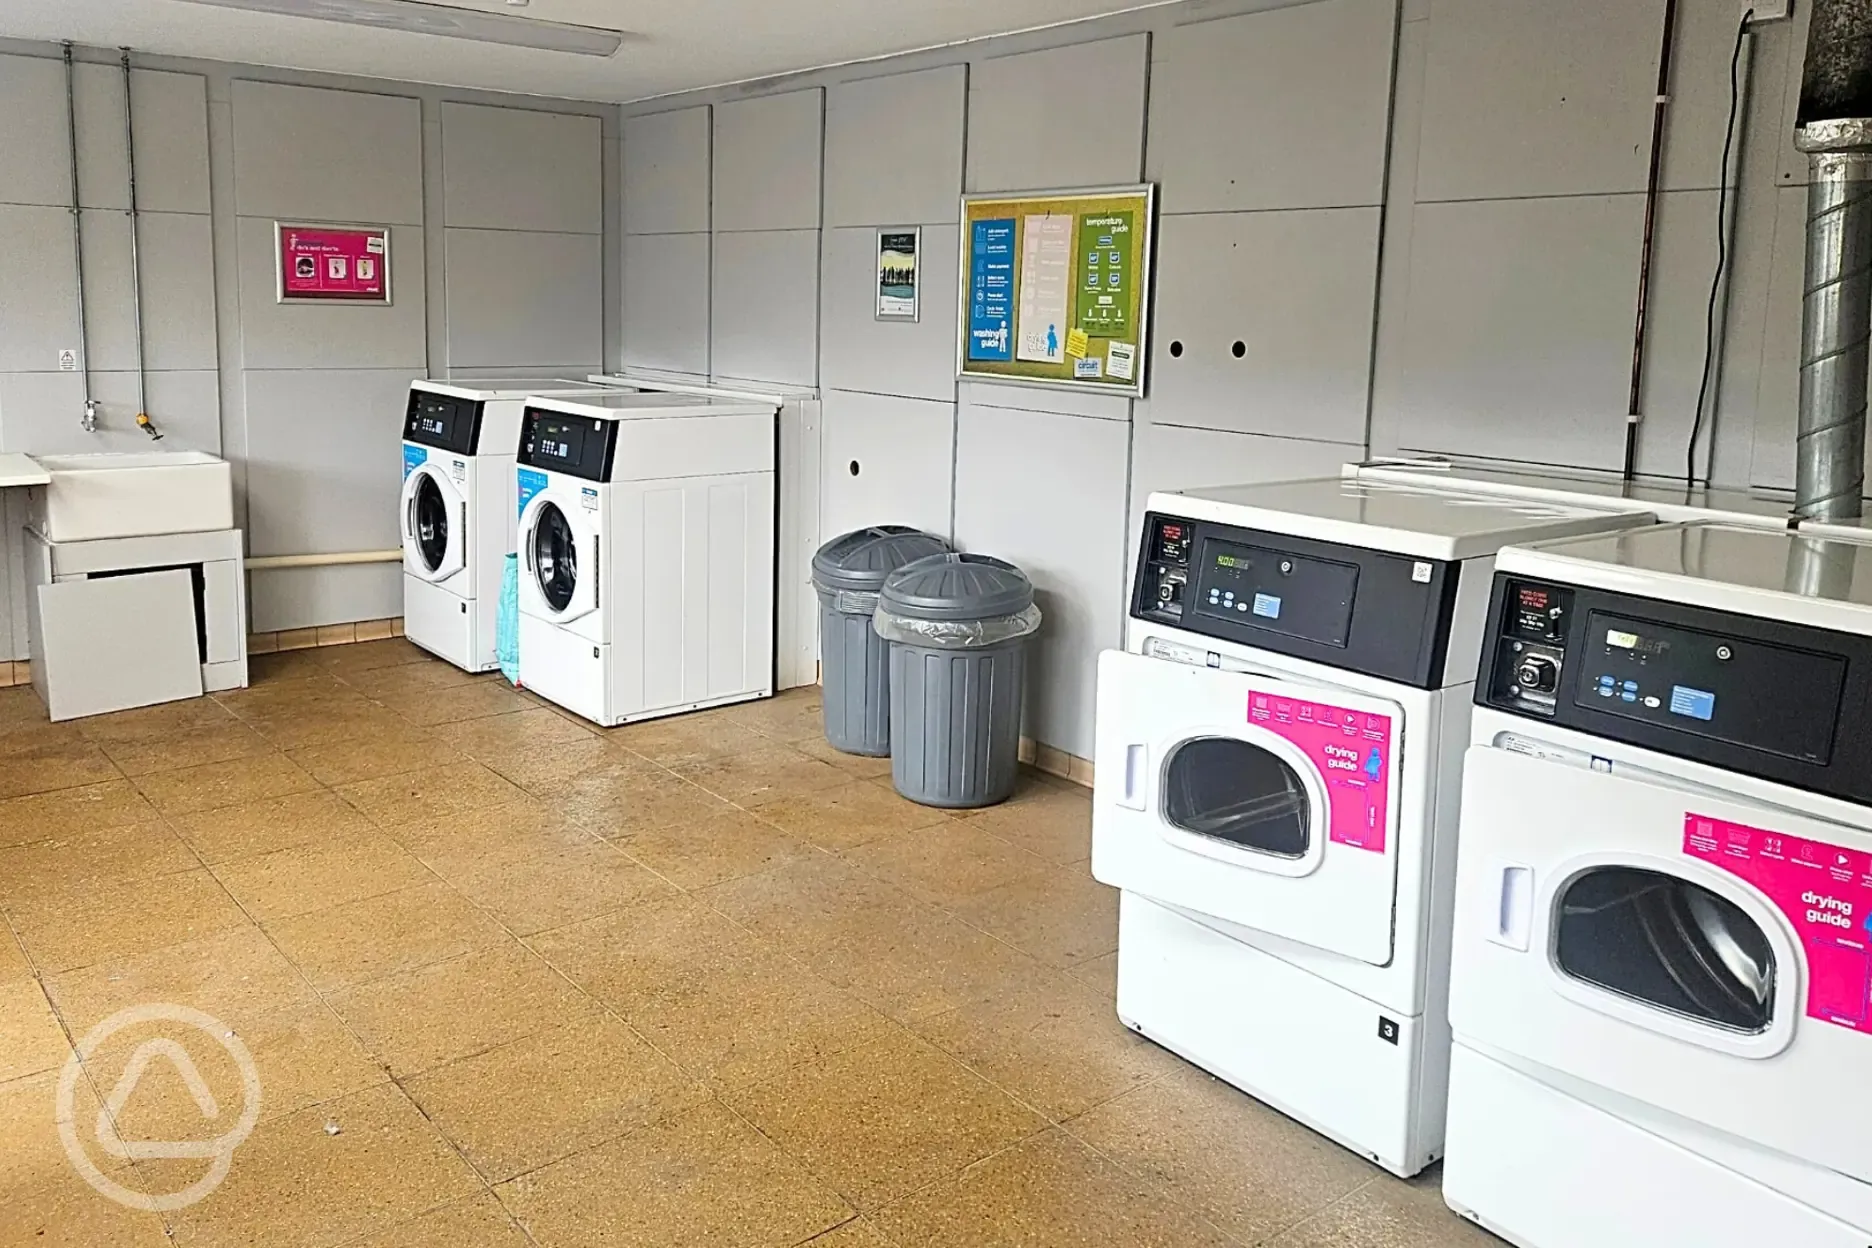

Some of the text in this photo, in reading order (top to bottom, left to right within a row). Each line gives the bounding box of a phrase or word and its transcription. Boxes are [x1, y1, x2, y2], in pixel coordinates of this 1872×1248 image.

[1086, 217, 1123, 227] temperature
[1111, 225, 1129, 235] guide
[973, 328, 1000, 340] washing
[981, 338, 999, 349] guide
[1324, 744, 1358, 761] drying
[1328, 758, 1357, 772] guide
[1801, 890, 1852, 915] drying
[1806, 909, 1851, 929] guide
[1384, 1024, 1393, 1038] 3
